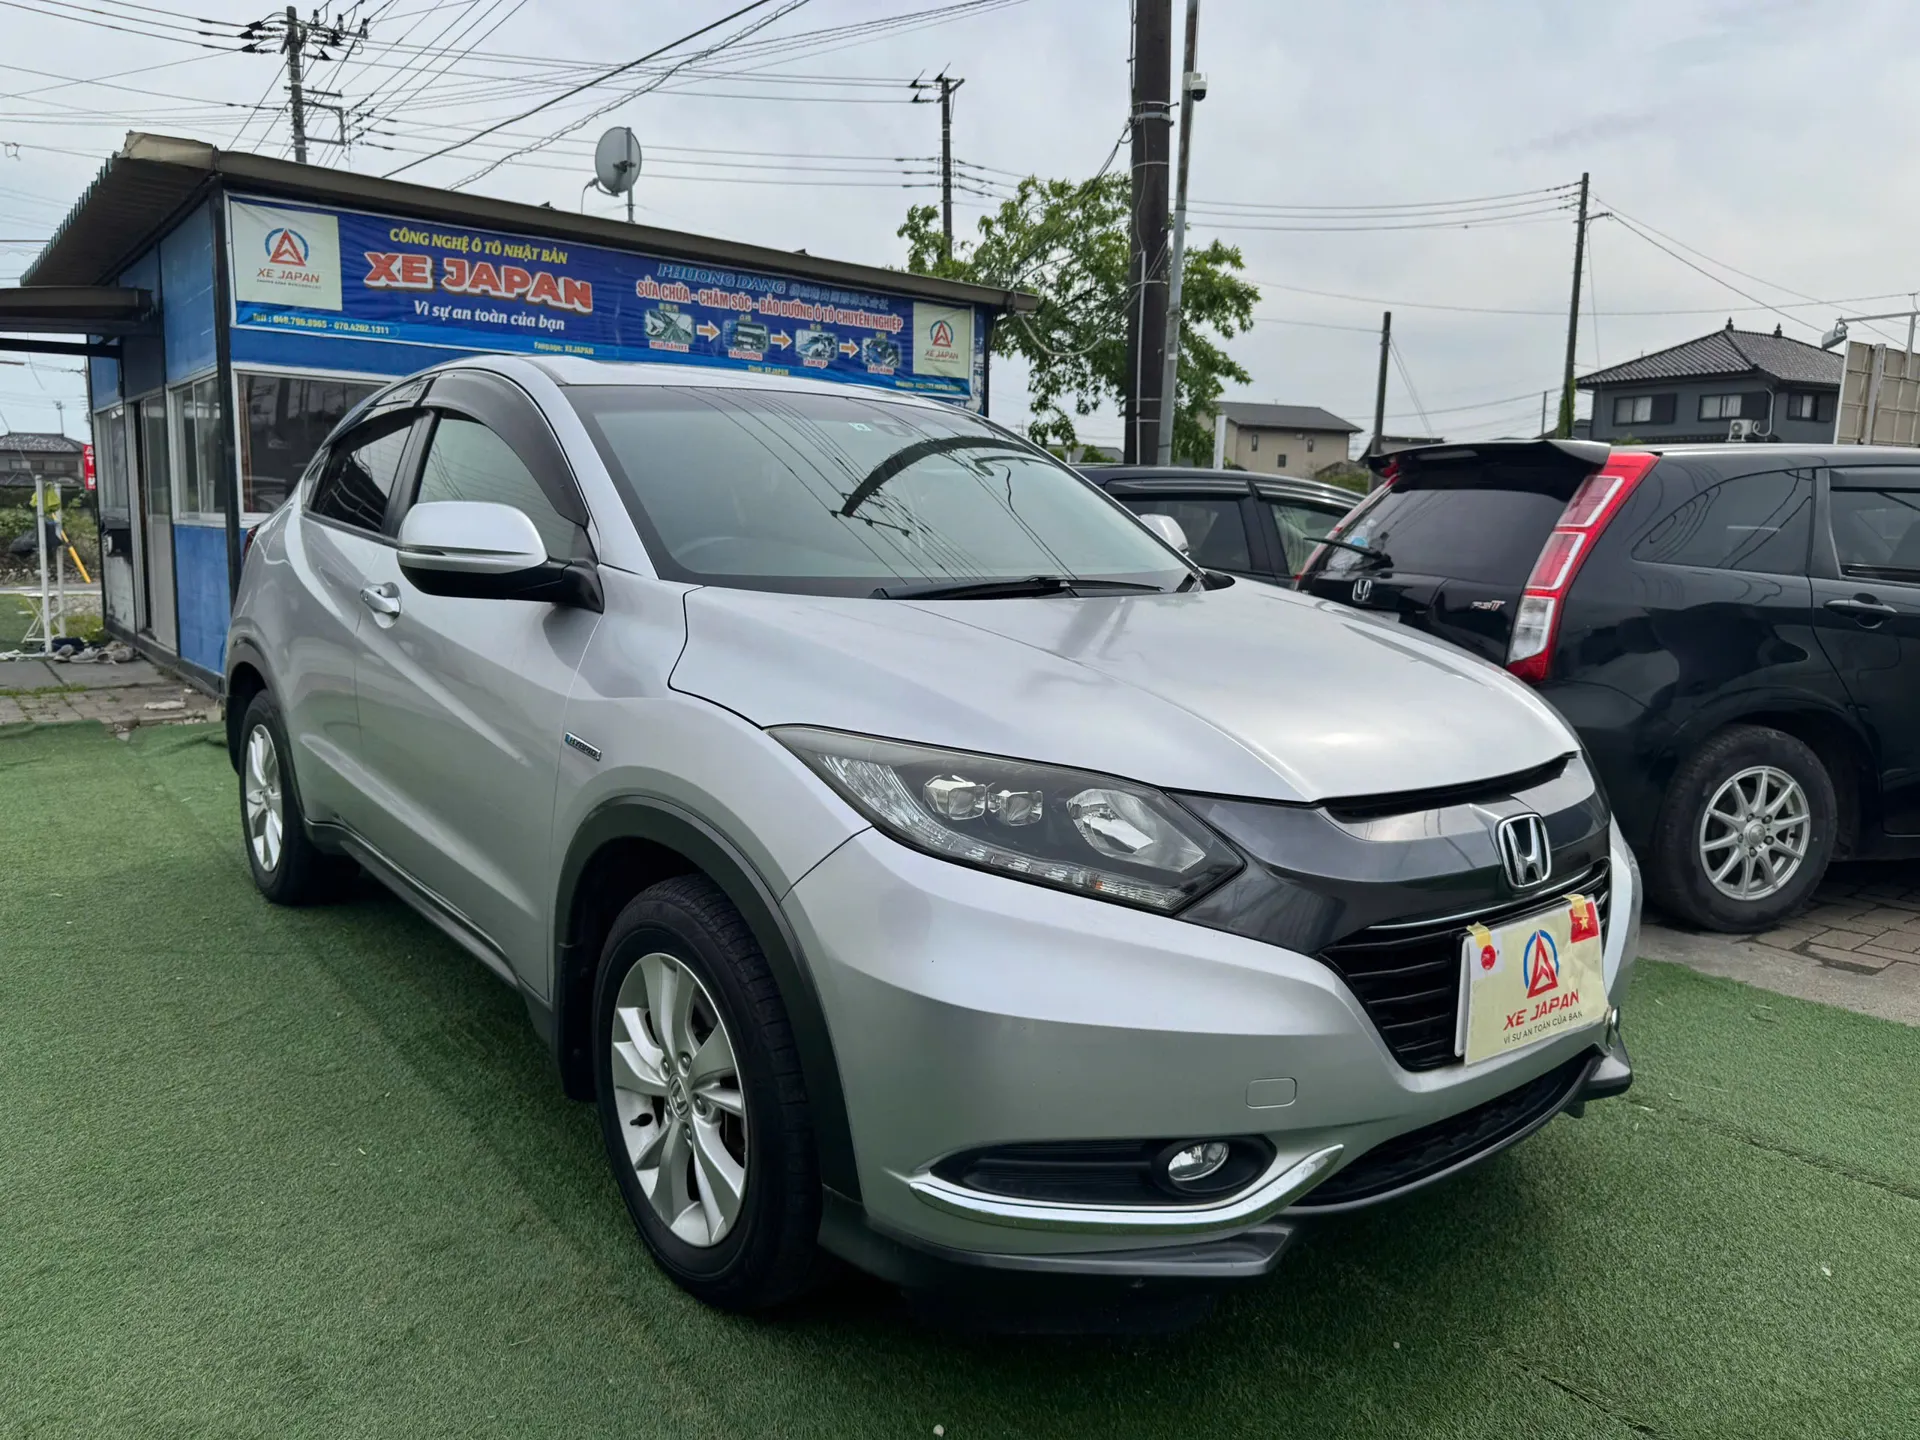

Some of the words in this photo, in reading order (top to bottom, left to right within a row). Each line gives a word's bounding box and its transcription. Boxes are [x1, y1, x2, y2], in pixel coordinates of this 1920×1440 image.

[389, 226, 430, 246] CÔNG
[432, 232, 469, 254] NGHỆ
[471, 235, 482, 253] Ô
[485, 239, 502, 256] TÔ
[504, 243, 540, 262] NHẬT
[541, 246, 568, 265] BẢN
[257, 268, 275, 278] XE
[277, 270, 320, 284] JAPAN
[364, 251, 434, 289] XE
[441, 257, 593, 314] JAPAN
[413, 300, 429, 316] Vì
[432, 303, 451, 321] sự
[452, 308, 471, 320] an
[474, 307, 508, 324] toàn
[510, 311, 536, 328] của
[539, 314, 566, 332] bạn
[636, 275, 660, 299] SỬA
[661, 282, 691, 304] CHỮA
[731, 292, 751, 312] SÓC
[759, 294, 780, 316] BẢO
[781, 299, 813, 320] DƯỠNG
[814, 302, 823, 322] Ô
[823, 304, 836, 323] TÔ
[836, 308, 872, 328] CHUYÊN
[872, 313, 904, 334] NGHIỆP
[1503, 1009, 1527, 1031] XE
[1530, 989, 1580, 1022] JAPAN
[1523, 1028, 1533, 1039] AN
